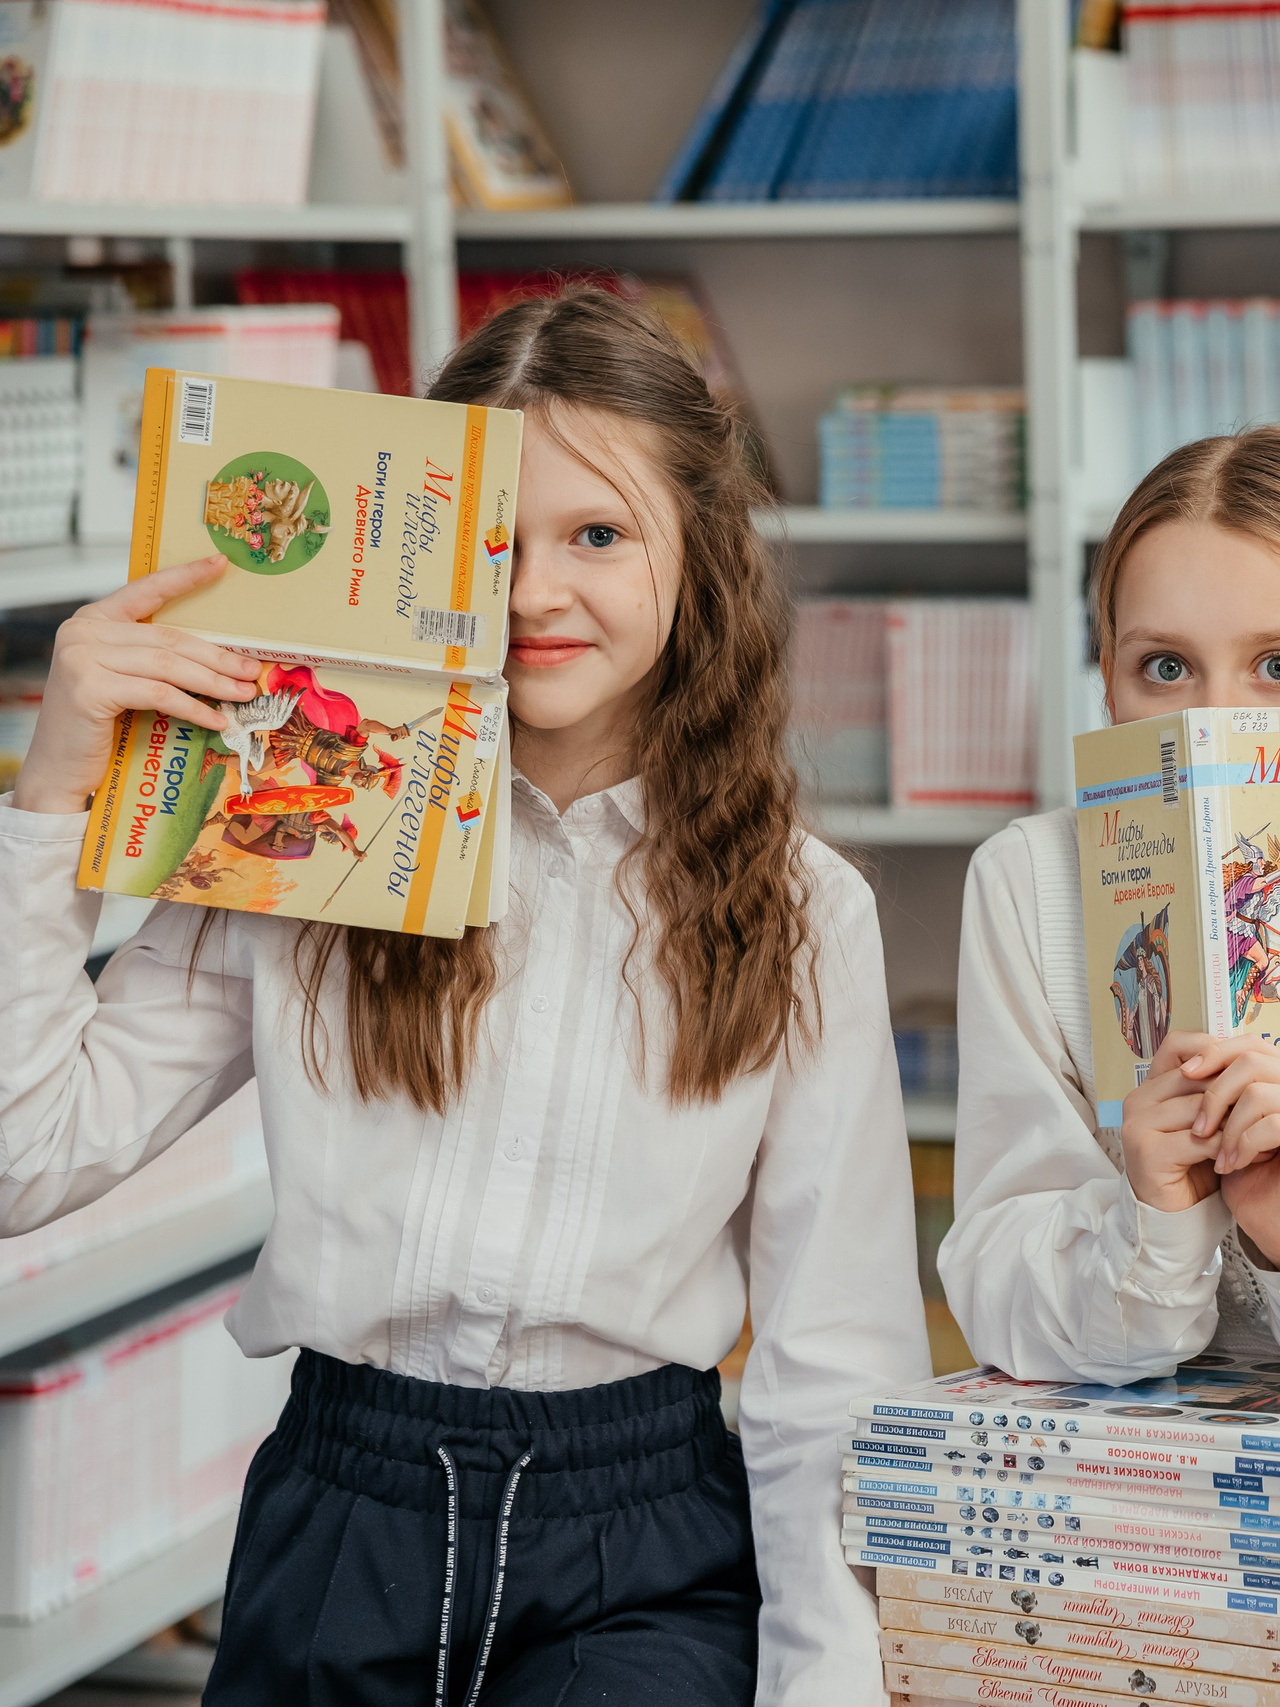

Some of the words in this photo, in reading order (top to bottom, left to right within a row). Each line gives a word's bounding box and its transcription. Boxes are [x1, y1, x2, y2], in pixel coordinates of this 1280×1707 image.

[467, 425, 482, 480] Школьная
[375, 452, 391, 487] Боги
[374, 489, 385, 500] и
[406, 492, 421, 510] и
[415, 456, 454, 554] Мифы
[462, 482, 475, 543] программа
[352, 484, 372, 563] Древнего
[494, 488, 509, 544] Классика
[369, 503, 384, 549] герои
[396, 512, 418, 619] легенды
[492, 558, 501, 596] детям
[348, 568, 365, 606] Рима
[256, 649, 297, 660] герои
[302, 654, 369, 669] Древнего
[373, 664, 412, 674] Рима
[1233, 712, 1253, 720] ББК
[175, 727, 194, 741] и
[1252, 722, 1268, 731] 739
[416, 730, 437, 754] и
[428, 683, 482, 811] Мифы
[114, 759, 123, 767] и
[160, 747, 189, 815] герои
[466, 757, 486, 810] Классика
[100, 768, 121, 833] внеклассное
[1203, 797, 1213, 833] Европы
[125, 803, 156, 858] Рима
[387, 755, 430, 898] легенды
[1099, 810, 1144, 849] Мифы
[459, 824, 472, 861] детям
[1118, 845, 1125, 862] и
[1126, 832, 1175, 860] легенды
[91, 834, 107, 873] чтение
[1203, 836, 1217, 878] Древней
[1101, 870, 1120, 886] Боги
[1120, 870, 1126, 883] и
[1127, 866, 1151, 885] герои
[1113, 884, 1146, 905] Древней
[1147, 882, 1175, 900] Европы
[1208, 880, 1218, 906] герои
[1210, 917, 1218, 941] Боги
[1212, 953, 1222, 1007] легенды
[876, 1406, 909, 1416] РОССИИ
[911, 1409, 950, 1420] ИСТОРИЯ
[872, 1424, 904, 1434] РОССИИ
[906, 1428, 944, 1439] ИСТОРИЯ
[1106, 1425, 1141, 1437] НАУКА
[1146, 1429, 1215, 1443] РОССИЙСКАЯ
[853, 1441, 885, 1452] РОССИИ
[887, 1445, 925, 1456] ИСТОРИЯ
[858, 1456, 890, 1466] РОССИИ
[1107, 1447, 1172, 1463] ЛОМОНОСОВ
[1176, 1454, 1198, 1465] М.В.
[893, 1459, 931, 1470] ИСТОРИЯ
[1076, 1463, 1110, 1475] ТАЙНЫ
[1114, 1466, 1181, 1481] МОСКОВСКИЕ
[509, 1472, 521, 1492] MAKE
[860, 1480, 894, 1490] РОССИИ
[896, 1484, 936, 1494] ИСТОРИЯ
[1066, 1477, 1122, 1492] КАЛЕНДАРЬ
[507, 1492, 514, 1501] IT
[1126, 1483, 1183, 1498] НАРОДНЫЙ
[503, 1500, 513, 1516] FUN
[858, 1498, 891, 1508] РОССИИ
[893, 1502, 932, 1512] ИСТОРИЯ
[869, 1518, 902, 1528] РОССИИ
[904, 1521, 943, 1532] ИСТОРИЯ
[1114, 1523, 1155, 1537] ПОБЕДЫ
[872, 1536, 904, 1545] РОССИИ
[1053, 1534, 1079, 1546] РУСИ
[1158, 1528, 1202, 1541] РУССКИЕ
[906, 1539, 946, 1550] ИСТОРИЯ
[1081, 1537, 1150, 1553] МОСКОВСКОЙ
[1153, 1544, 1170, 1554] ВЕК
[861, 1552, 894, 1561] РОССИИ
[896, 1555, 935, 1567] ИСТОРИЯ
[1173, 1546, 1222, 1560] ЗОЛОТОЙ
[1112, 1561, 1149, 1573] ВОЙНА
[1152, 1565, 1228, 1582] ГРАЖДАНСКАЯ
[495, 1572, 504, 1593] MAKE
[1094, 1579, 1160, 1595] ИМПЕРАТОРЫ
[943, 1586, 993, 1605] ДРУЗЬЯ
[1163, 1589, 1170, 1598] И
[1173, 1590, 1200, 1600] ЦАРИ
[491, 1601, 500, 1617] FUN
[1062, 1597, 1133, 1629] Чарушин
[947, 1617, 997, 1635] ДРУЗЬЯ
[1137, 1610, 1195, 1637] Евгений
[1067, 1629, 1138, 1661] Чарушин
[437, 1649, 446, 1671] MAKE
[1142, 1642, 1200, 1669] Евгений
[971, 1646, 1028, 1671] Евгений
[1031, 1654, 1103, 1684] Чарушин
[436, 1678, 444, 1694] FUN
[978, 1678, 1033, 1703] Евгений
[1175, 1680, 1228, 1698] ДРУЗЬЯ
